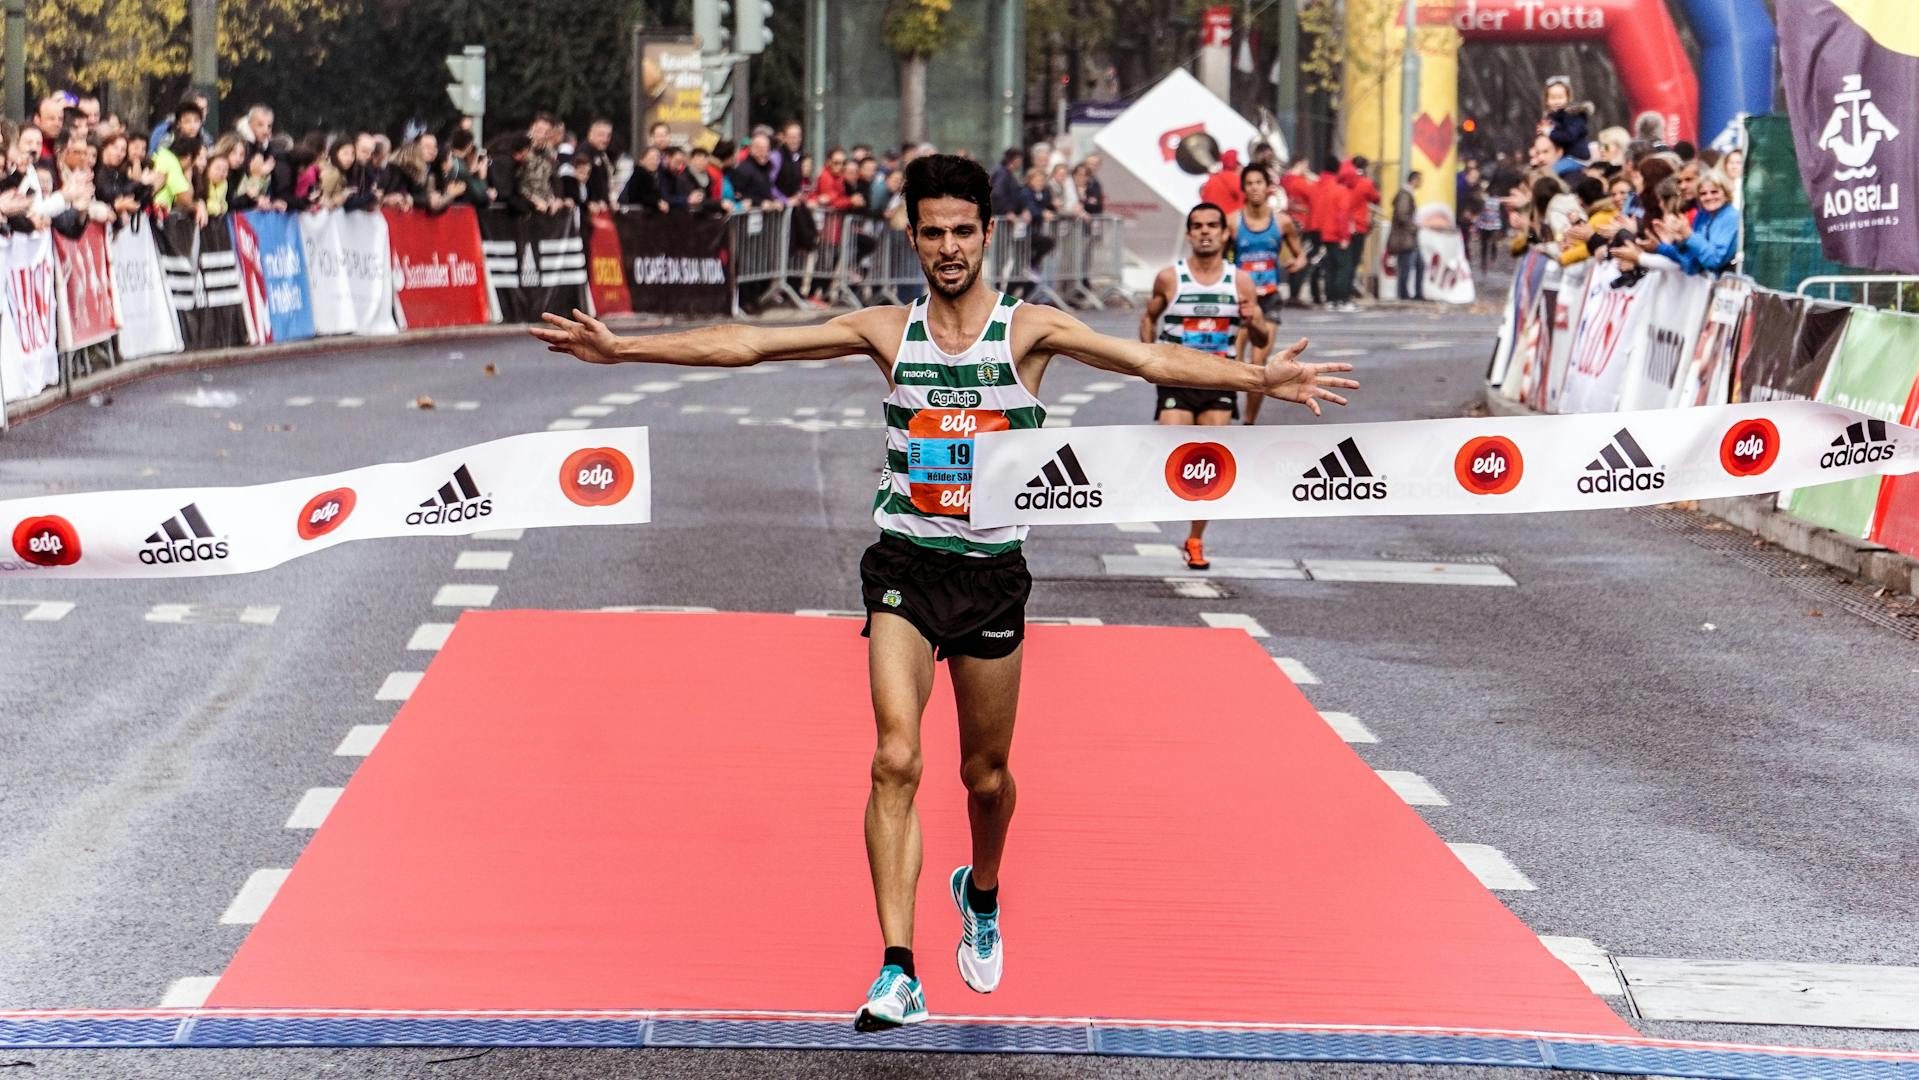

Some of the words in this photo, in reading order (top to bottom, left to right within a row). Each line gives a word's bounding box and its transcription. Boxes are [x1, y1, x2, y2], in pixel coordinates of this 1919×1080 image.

[1515, 0, 1604, 30] Totta
[403, 252, 449, 288] Santander
[449, 252, 477, 287] Totta
[701, 257, 725, 284] VIDA
[902, 370, 939, 378] macron
[932, 391, 977, 406] Agriloja
[940, 410, 977, 437] edp
[911, 443, 920, 464] 2017
[947, 443, 970, 465] 19
[927, 472, 955, 481] Hélder
[1014, 486, 1102, 510] adidas
[1182, 458, 1216, 484] edp
[1292, 477, 1387, 501] adidas
[1472, 452, 1506, 478] edp
[1577, 469, 1665, 493] adidas
[1734, 434, 1764, 466] edp
[1820, 439, 1895, 469] adidas
[30, 532, 63, 554] edp
[139, 539, 229, 565] adidas
[310, 501, 339, 523] edp
[406, 499, 492, 525] adidas
[577, 464, 614, 489] edp
[982, 629, 1014, 639] macron
